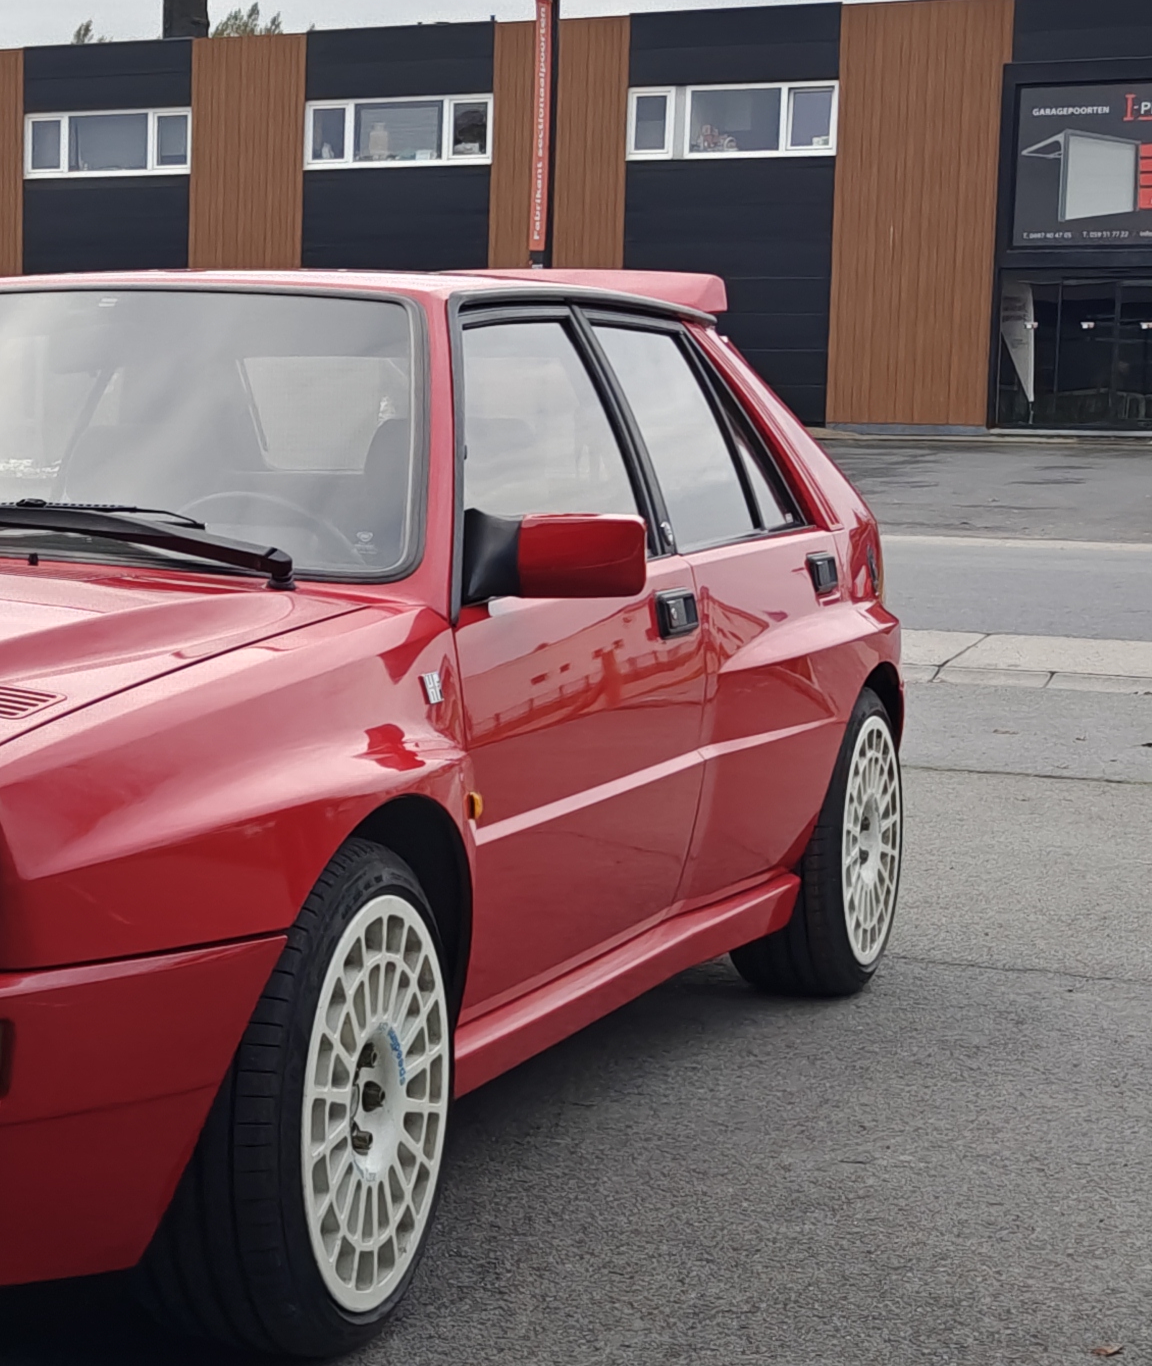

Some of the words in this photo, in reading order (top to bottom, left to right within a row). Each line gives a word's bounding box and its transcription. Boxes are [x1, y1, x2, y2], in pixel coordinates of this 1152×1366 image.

[537, 7, 546, 156] sectionaalpoorten
[1032, 105, 1110, 116] GARAGEPOORTEN
[533, 161, 543, 240] Fabrikant
